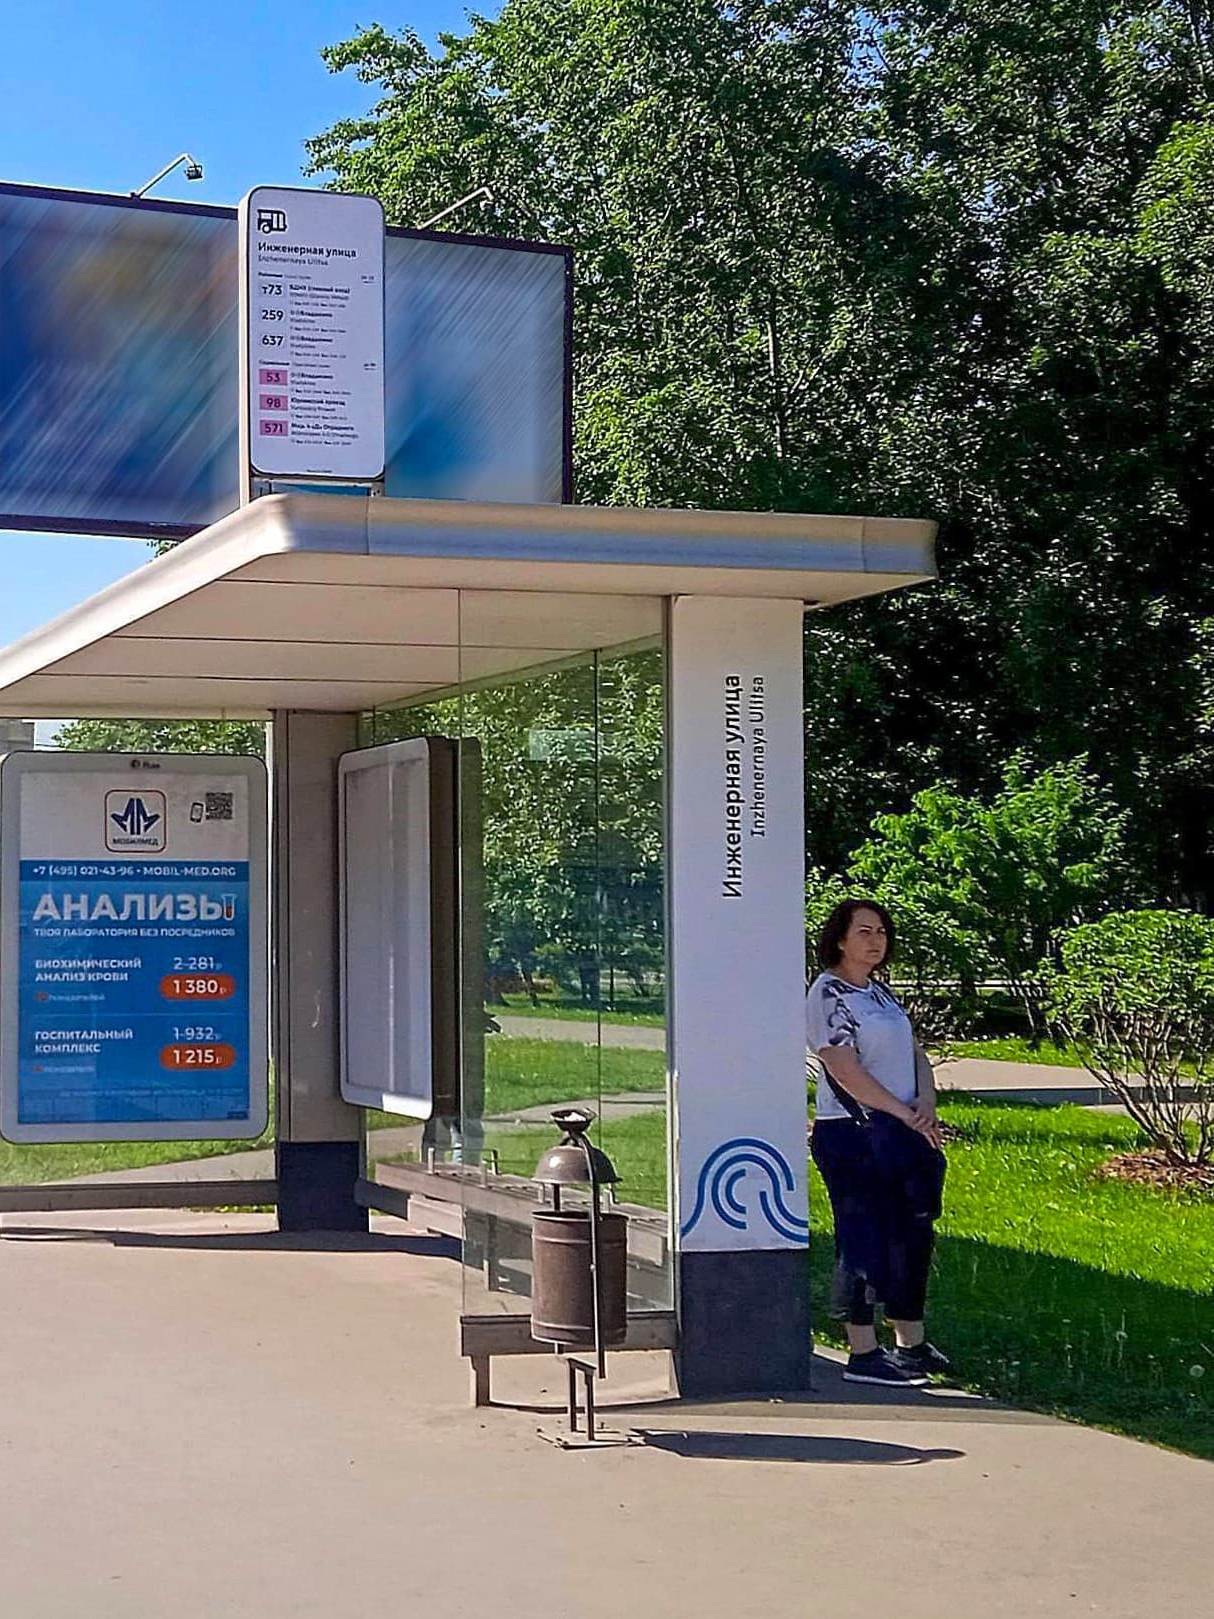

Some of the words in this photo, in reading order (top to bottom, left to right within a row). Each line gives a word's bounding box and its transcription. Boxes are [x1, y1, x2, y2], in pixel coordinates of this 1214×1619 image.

[258, 242, 324, 256] Инженерная
[326, 247, 356, 258] улица
[262, 284, 282, 295] т73
[262, 309, 284, 320] 259
[262, 335, 284, 346] 637
[266, 373, 281, 383] 53
[266, 398, 281, 408] 98
[265, 423, 283, 433] 571
[749, 677, 764, 722] Ulitsa
[724, 675, 745, 744] улица
[750, 728, 768, 837] Inzhenernaya
[722, 748, 745, 898] Инженерная
[32, 866, 46, 875] +7
[49, 865, 77, 876] (495)
[79, 866, 135, 875] 021-43-96
[143, 866, 237, 876] MOBIL-MED.ORG
[32, 893, 237, 920] АНАЛИЗЫ
[34, 928, 61, 937] ТВОЯ
[63, 928, 138, 937] ЛАБОРАТОРИЯ
[140, 928, 159, 937] БЕЗ
[160, 928, 236, 937] ПОСРЕДНИКОВ
[35, 957, 142, 969] БИОХИМИЧЕСКИЙ
[35, 972, 85, 982] АНАЛИЗ
[88, 972, 128, 981] КРОВИ
[35, 1028, 134, 1040] ГОСПИТАЛЬНЫЙ
[35, 1043, 102, 1053] КОМПЛЕКС
